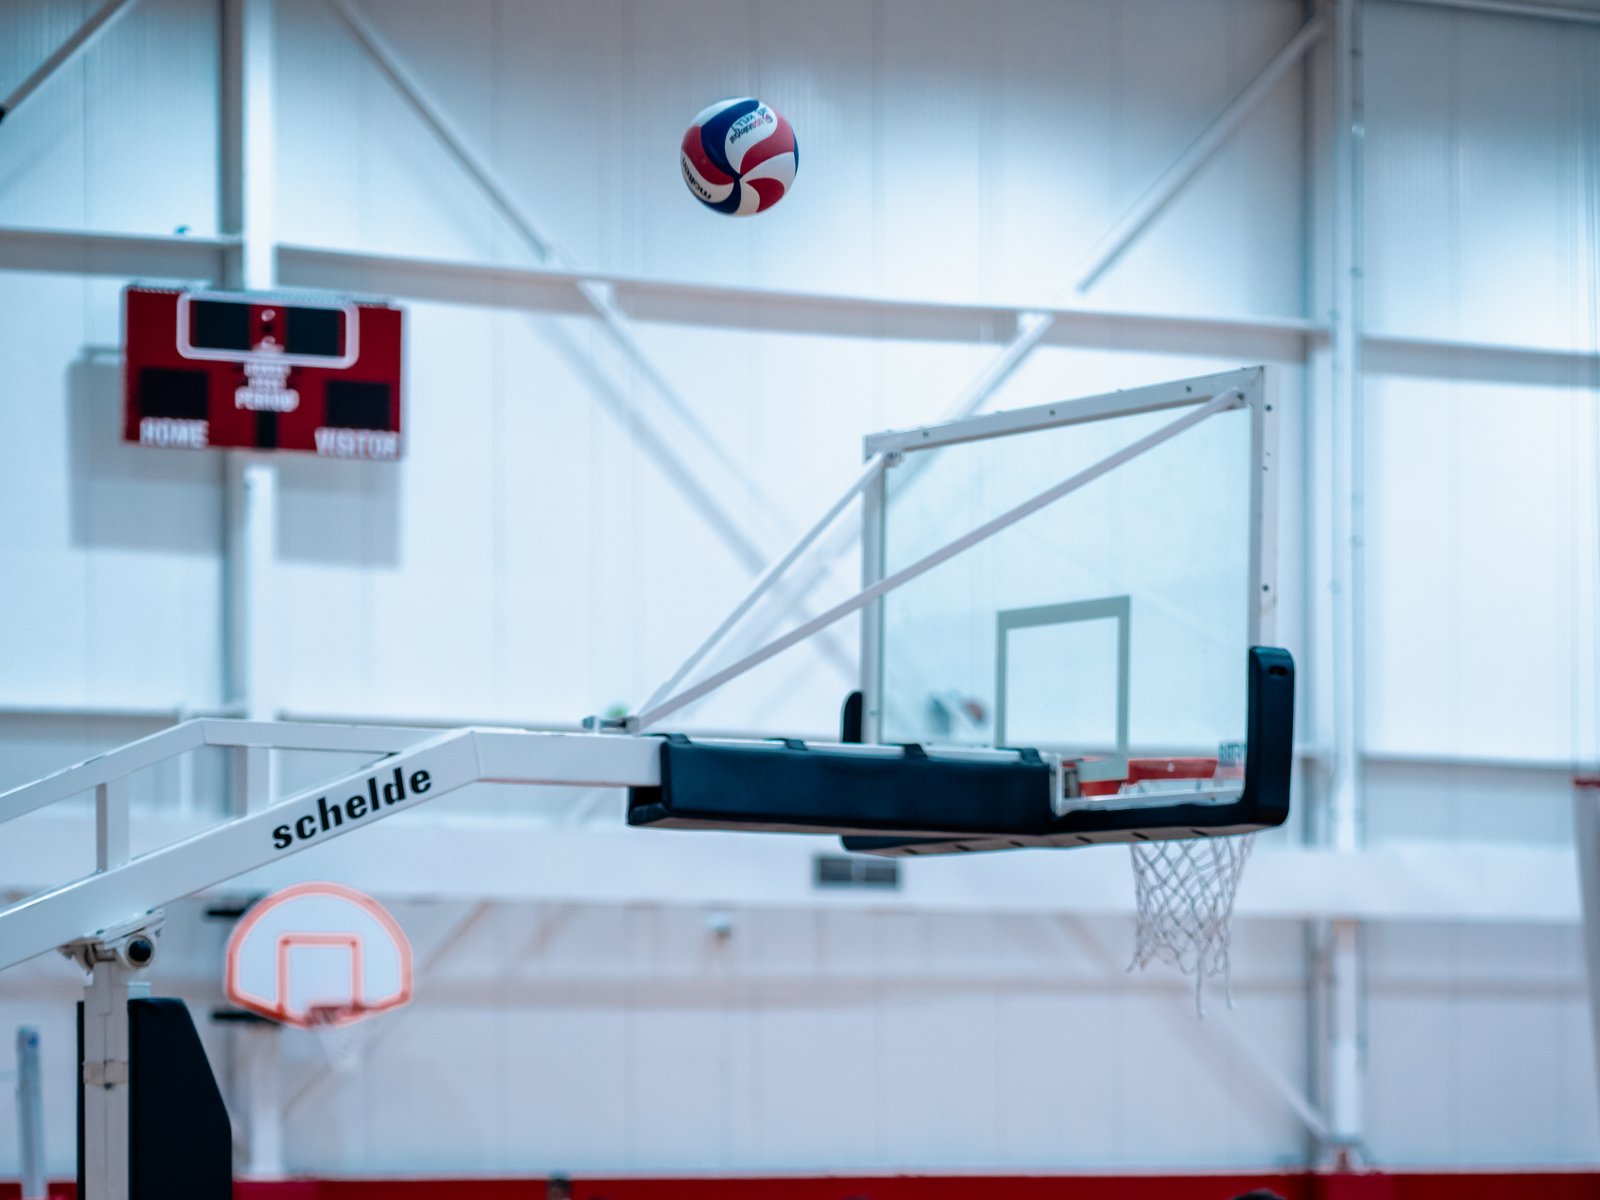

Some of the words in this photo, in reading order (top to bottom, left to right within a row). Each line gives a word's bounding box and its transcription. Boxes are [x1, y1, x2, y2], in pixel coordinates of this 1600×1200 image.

[140, 416, 210, 449] HOME
[314, 426, 400, 460] VISITOR
[272, 767, 432, 850] schelde
